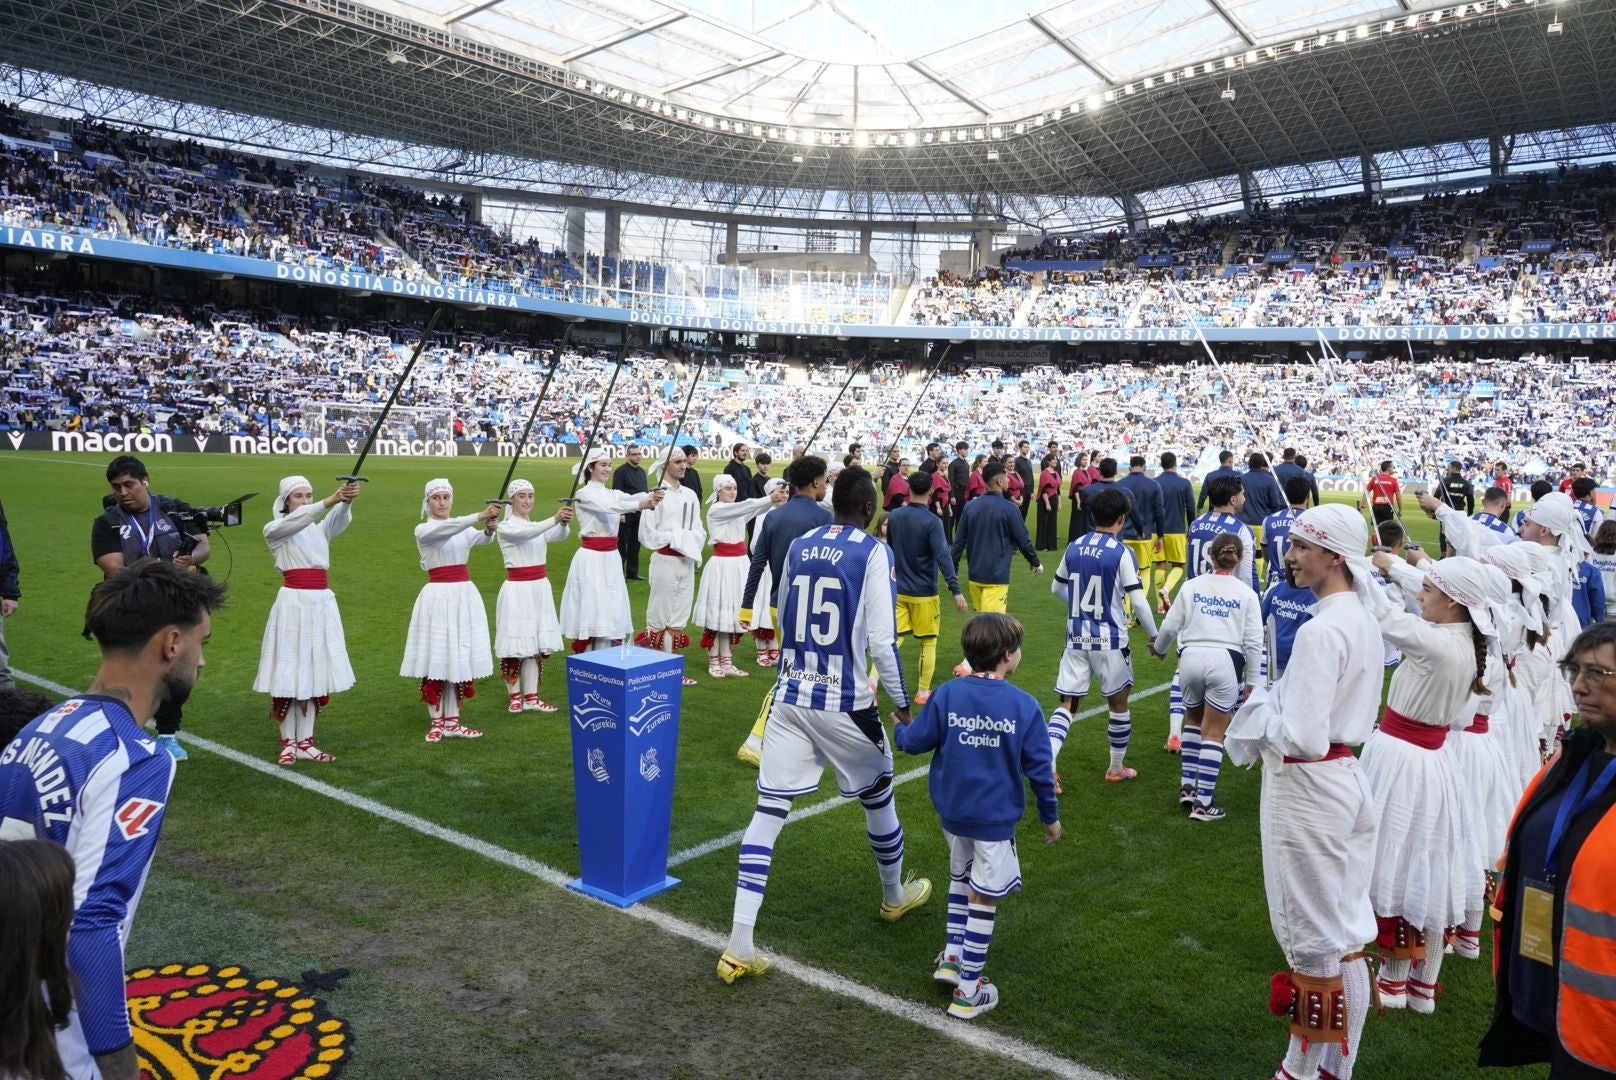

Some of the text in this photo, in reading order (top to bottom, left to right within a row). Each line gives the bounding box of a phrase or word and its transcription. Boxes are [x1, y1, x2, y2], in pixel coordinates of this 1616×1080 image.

[0, 227, 95, 255] IARRA
[277, 264, 518, 308] DONOSTIA DONOSTIARRA
[630, 310, 843, 336] DONOSTIA DONOSTIARRA
[970, 328, 1202, 340] DONOSTIA DONOSTIARRA
[1338, 325, 1616, 340] DONOSTIA DONOSTIARR
[52, 431, 173, 453] macron
[230, 435, 328, 455] macron
[376, 438, 458, 457] macron
[497, 441, 567, 458] macron
[802, 546, 844, 566] SADIQ
[1079, 546, 1104, 559] TAKE
[1069, 572, 1104, 620] 14
[1193, 593, 1241, 610] Baghdadi
[792, 574, 842, 646] 15
[1200, 606, 1230, 619] Capital
[1276, 607, 1298, 620] Capital
[1068, 632, 1110, 644] Kutxabank
[598, 674, 625, 687] Gipuzkoa
[657, 668, 682, 679] Gipuzkoa
[781, 658, 840, 685] Kutxabank
[590, 720, 617, 732] Zurekin
[645, 713, 671, 734] Zurekin
[948, 712, 1016, 734] Baghdadi
[958, 732, 1000, 748] Capital
